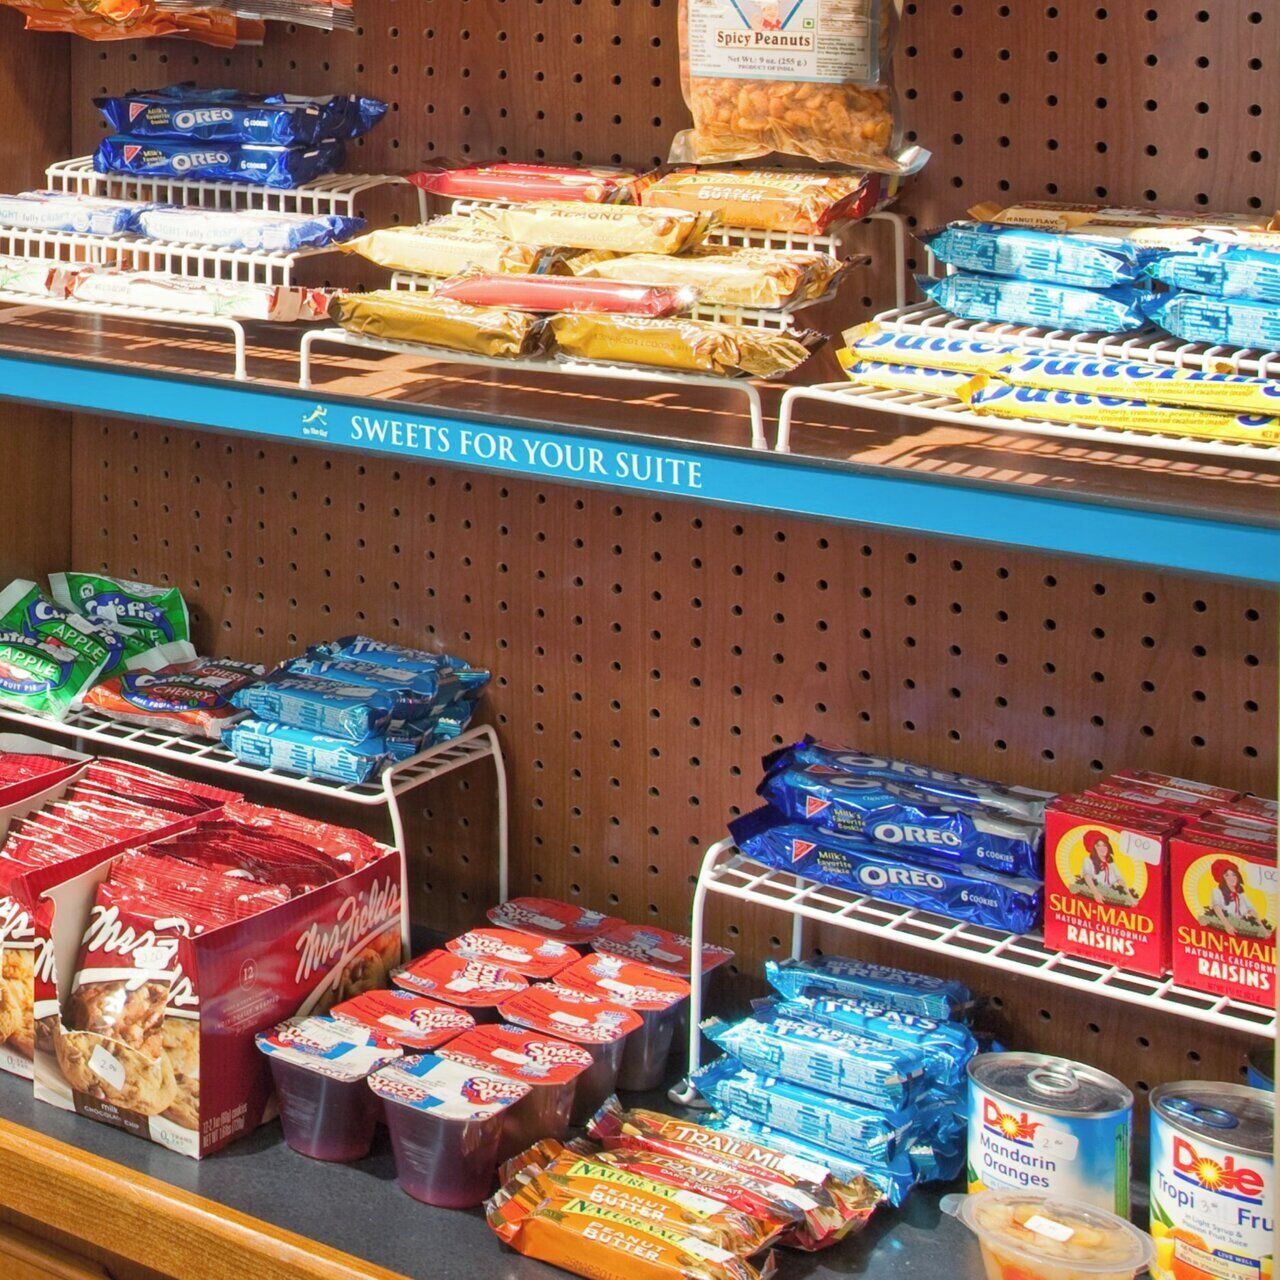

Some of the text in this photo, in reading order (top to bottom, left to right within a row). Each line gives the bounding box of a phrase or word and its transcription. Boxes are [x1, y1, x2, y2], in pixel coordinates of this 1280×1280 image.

[716, 30, 811, 47] Spicy Peanuts
[173, 108, 234, 129] OREO
[171, 151, 230, 171] OREO
[351, 415, 703, 489] SWEETS FOR YOUR SUITE
[127, 601, 156, 622] Pie
[52, 624, 106, 665] APPLE
[153, 684, 216, 701] CHERRY
[873, 822, 963, 846] OREO
[818, 850, 847, 862] Milk's
[976, 846, 1015, 863] 6 COOKIES
[859, 865, 946, 890] OREO
[960, 890, 998, 907] 6 COOKIES
[1048, 892, 1155, 934] SUN-MAID
[1055, 912, 1149, 943] NATURAL CALIFORNIA
[1066, 925, 1136, 957] RAISINS
[1184, 945, 1226, 962] NATURAL
[830, 966, 942, 990] TREATS
[1197, 956, 1271, 991] RAISINS
[410, 1007, 474, 1026] Snack
[420, 1016, 477, 1031] Pack
[825, 1000, 940, 1031] TREATS
[527, 1041, 592, 1060] Snack
[537, 1051, 594, 1066] Pack
[100, 1102, 119, 1115] milk
[674, 1125, 746, 1158] TRAIL
[979, 1131, 1057, 1174] Mandarin
[574, 1163, 647, 1190] NATURE
[649, 1155, 724, 1188] TRAIL
[983, 1154, 1051, 1189] Oranges
[1173, 1134, 1265, 1198] Dole
[590, 1189, 665, 1222] BUTTER
[593, 1183, 672, 1212] PEANUT
[569, 1199, 642, 1227] NATURE
[588, 1220, 666, 1253] PEANUT
[1210, 1222, 1235, 1240] Syrup
[1227, 1234, 1249, 1248] Juice
[582, 1228, 661, 1262] BUTTER
[1216, 1250, 1254, 1267] LIVE WELL
